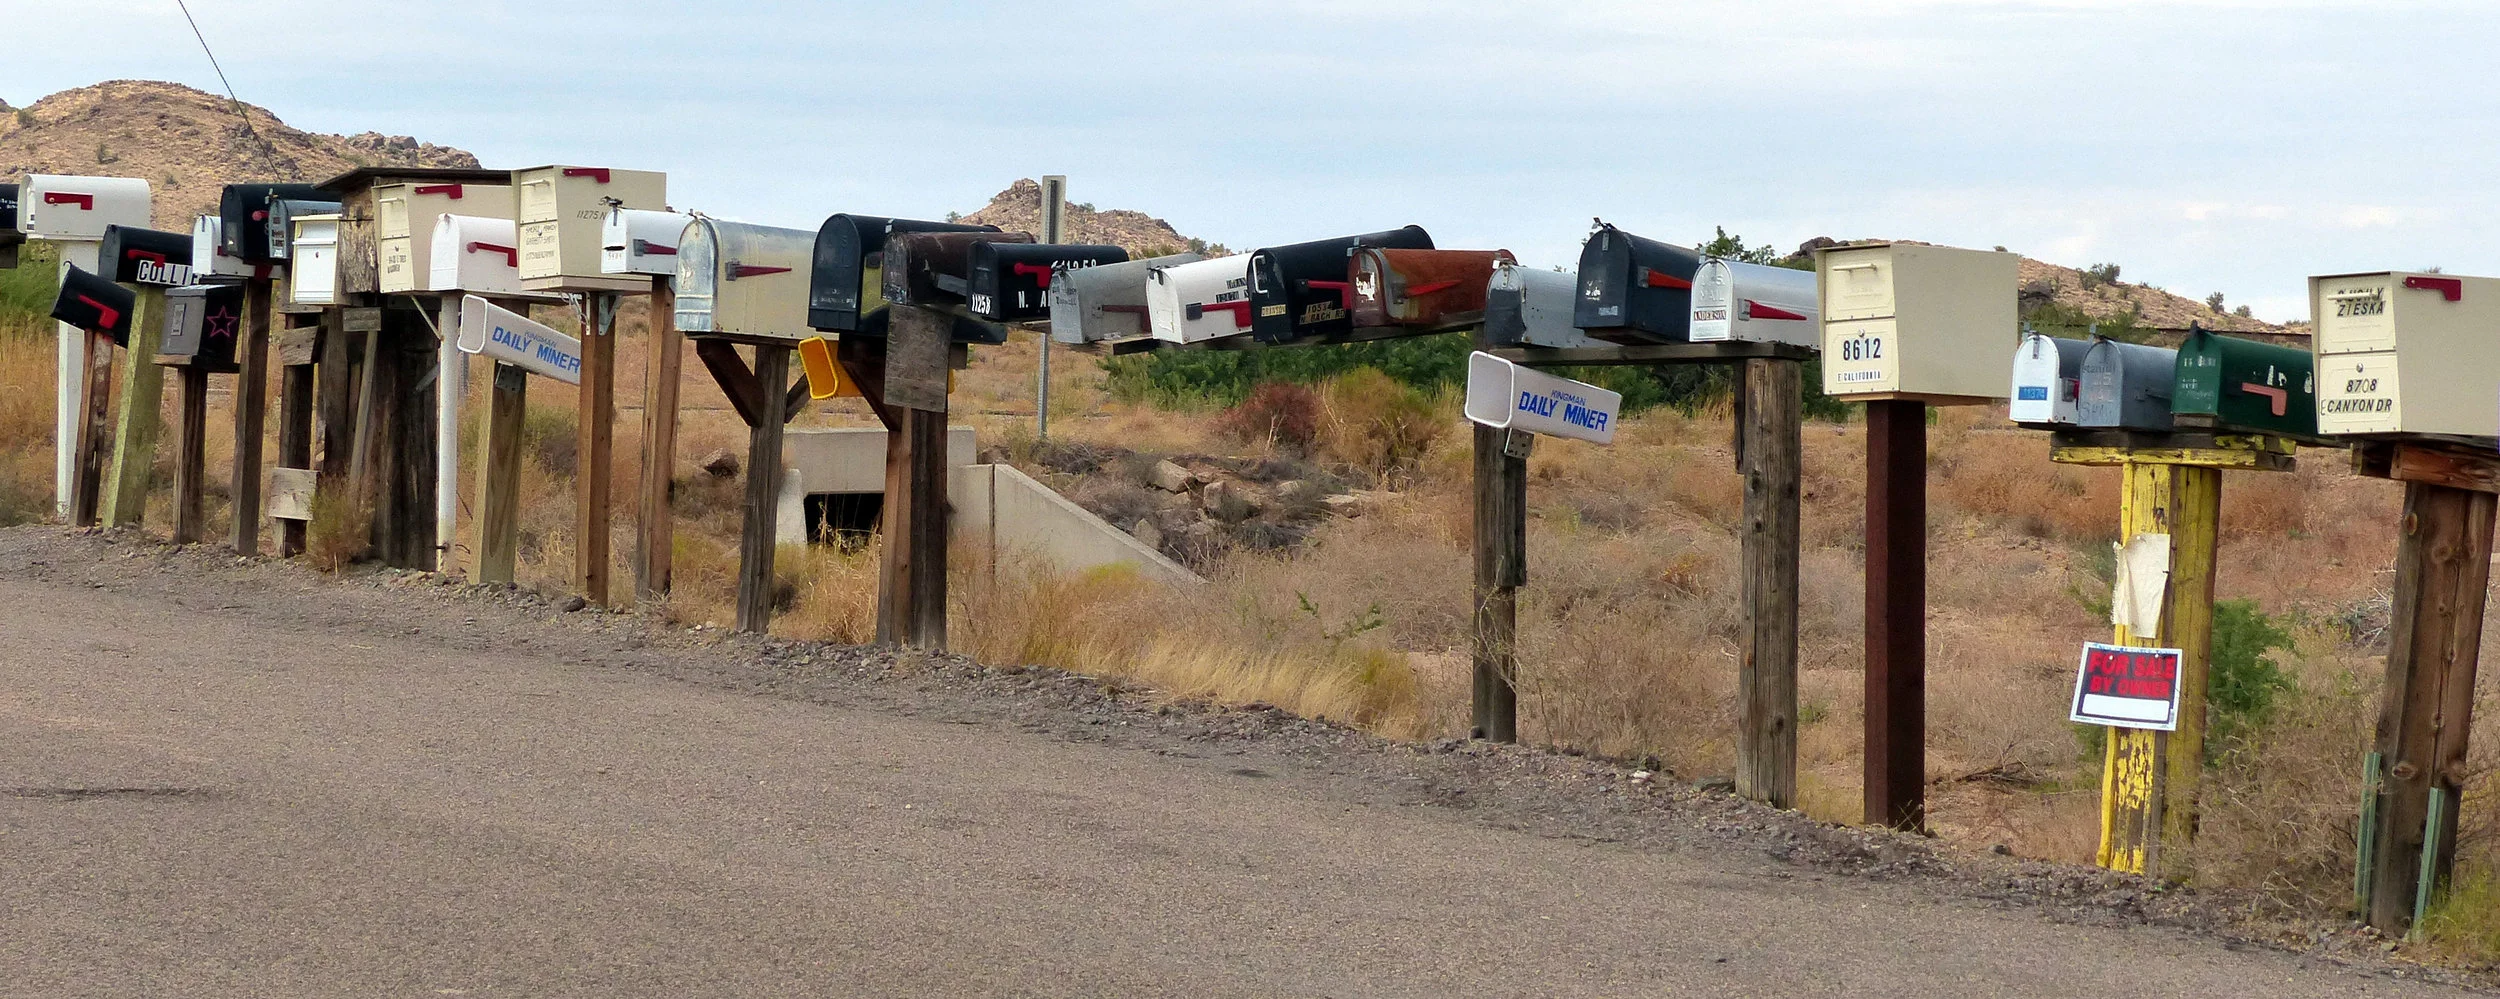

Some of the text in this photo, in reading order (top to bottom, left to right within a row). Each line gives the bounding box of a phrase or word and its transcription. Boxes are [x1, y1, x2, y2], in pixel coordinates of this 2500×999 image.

[577, 210, 607, 221] 11275 N
[971, 294, 991, 315] 11258
[2337, 301, 2385, 317] ZIESKA
[492, 325, 581, 375] DAILY MINER
[1843, 337, 1881, 361] 8612
[1837, 370, 1881, 382] E CALIFORNIA
[2346, 378, 2378, 394] 8708
[1550, 389, 1586, 406] KINGMAN
[2327, 399, 2374, 413] CANYON
[2376, 398, 2393, 412] DR
[1518, 391, 1609, 433] DAILY MINER
[2088, 651, 2176, 679] FOR SALE
[2089, 675, 2171, 698] BY OWNER
